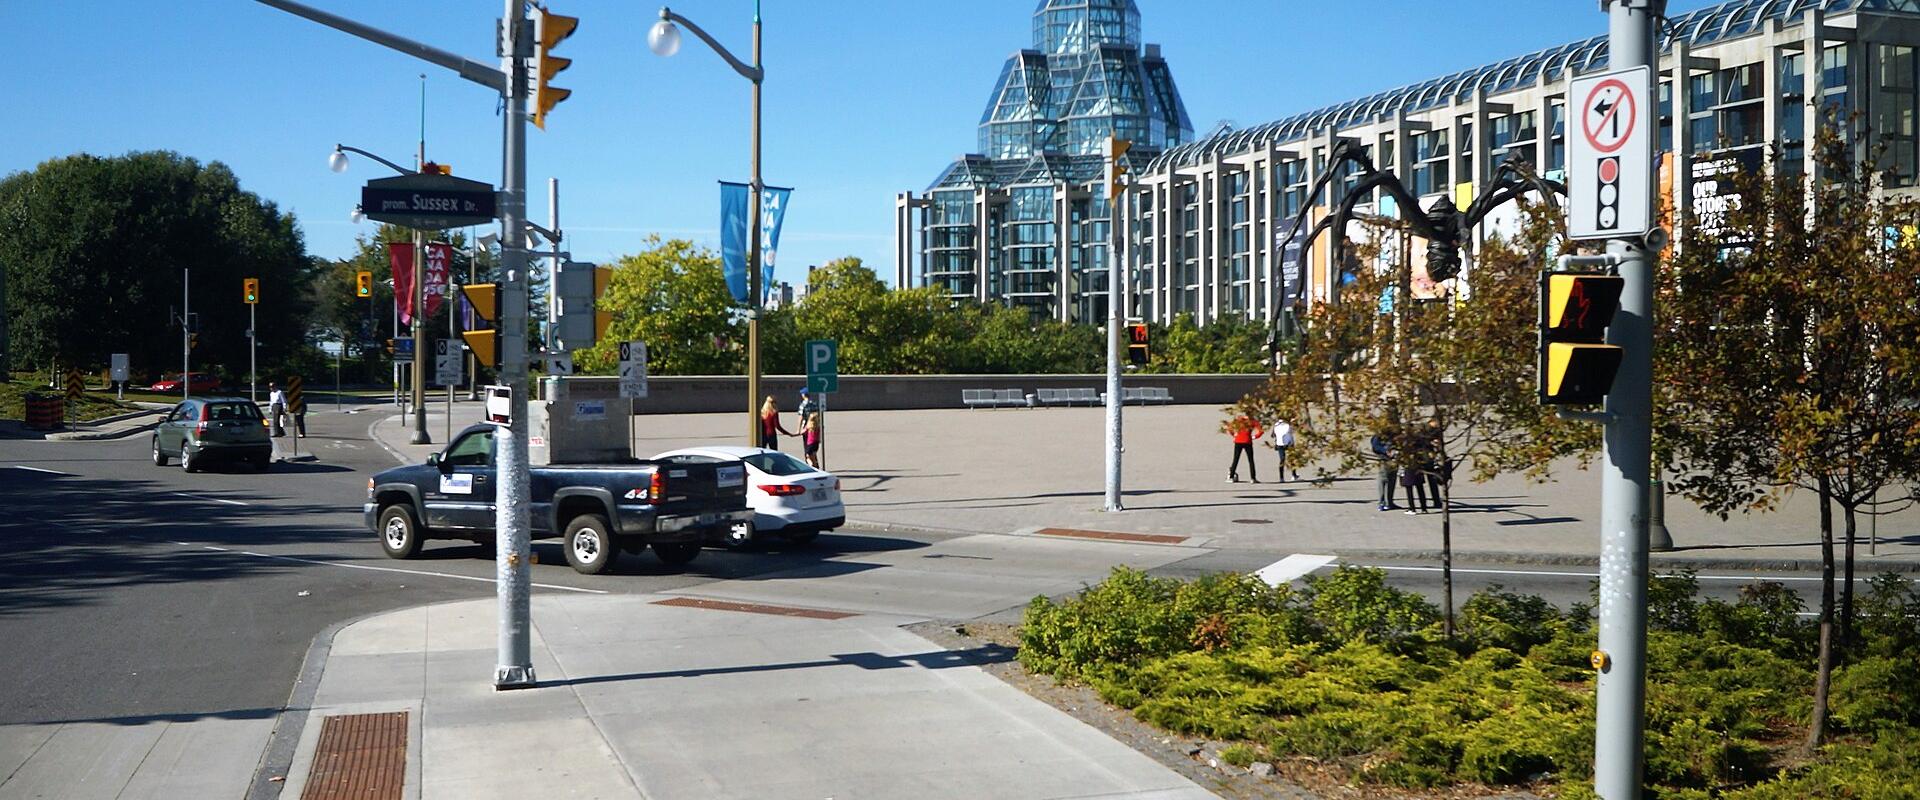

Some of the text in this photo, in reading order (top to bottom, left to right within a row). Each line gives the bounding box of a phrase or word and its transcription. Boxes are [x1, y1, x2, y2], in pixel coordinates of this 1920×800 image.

[382, 194, 479, 212] prom. Sussex Dr.
[812, 344, 832, 372] P
